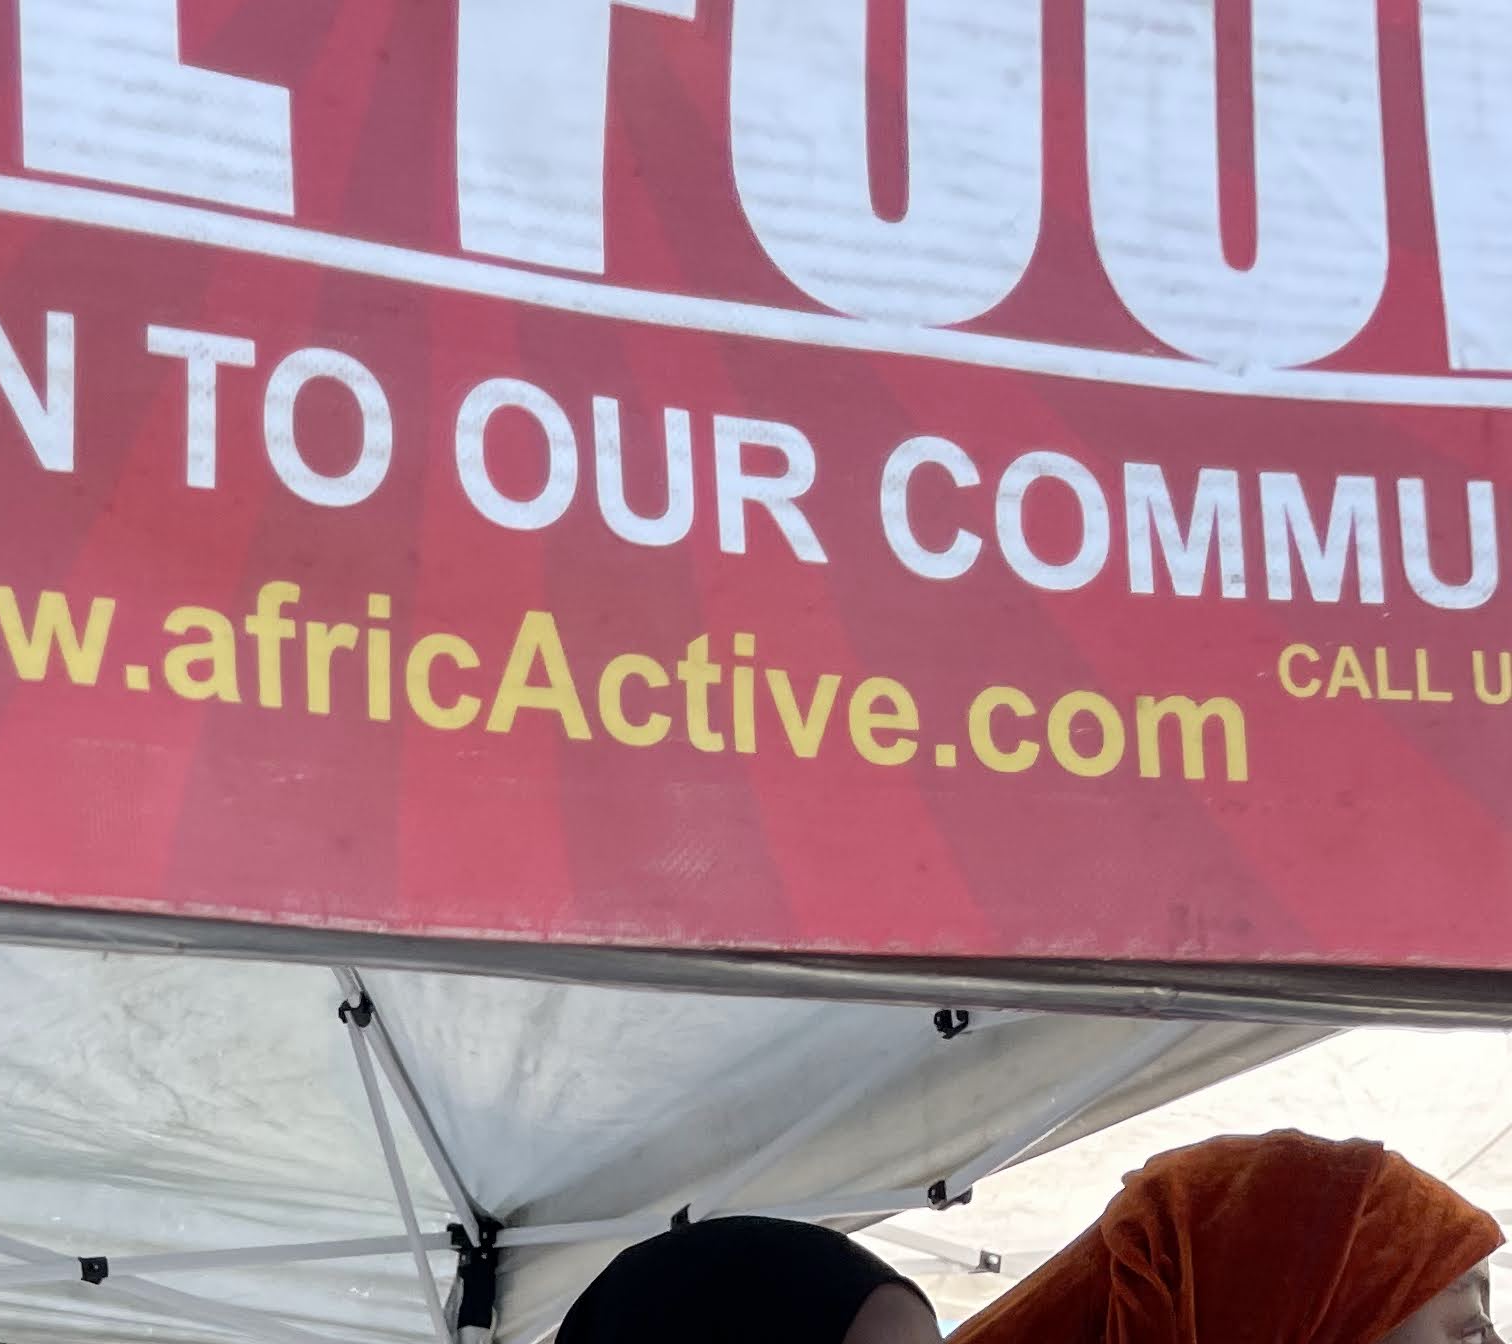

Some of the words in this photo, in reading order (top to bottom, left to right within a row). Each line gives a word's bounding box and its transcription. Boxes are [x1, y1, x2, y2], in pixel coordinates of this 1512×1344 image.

[146, 324, 393, 508] TO
[453, 375, 829, 564] OUR
[879, 434, 1500, 610] COMMU
[1278, 643, 1454, 704] CALL
